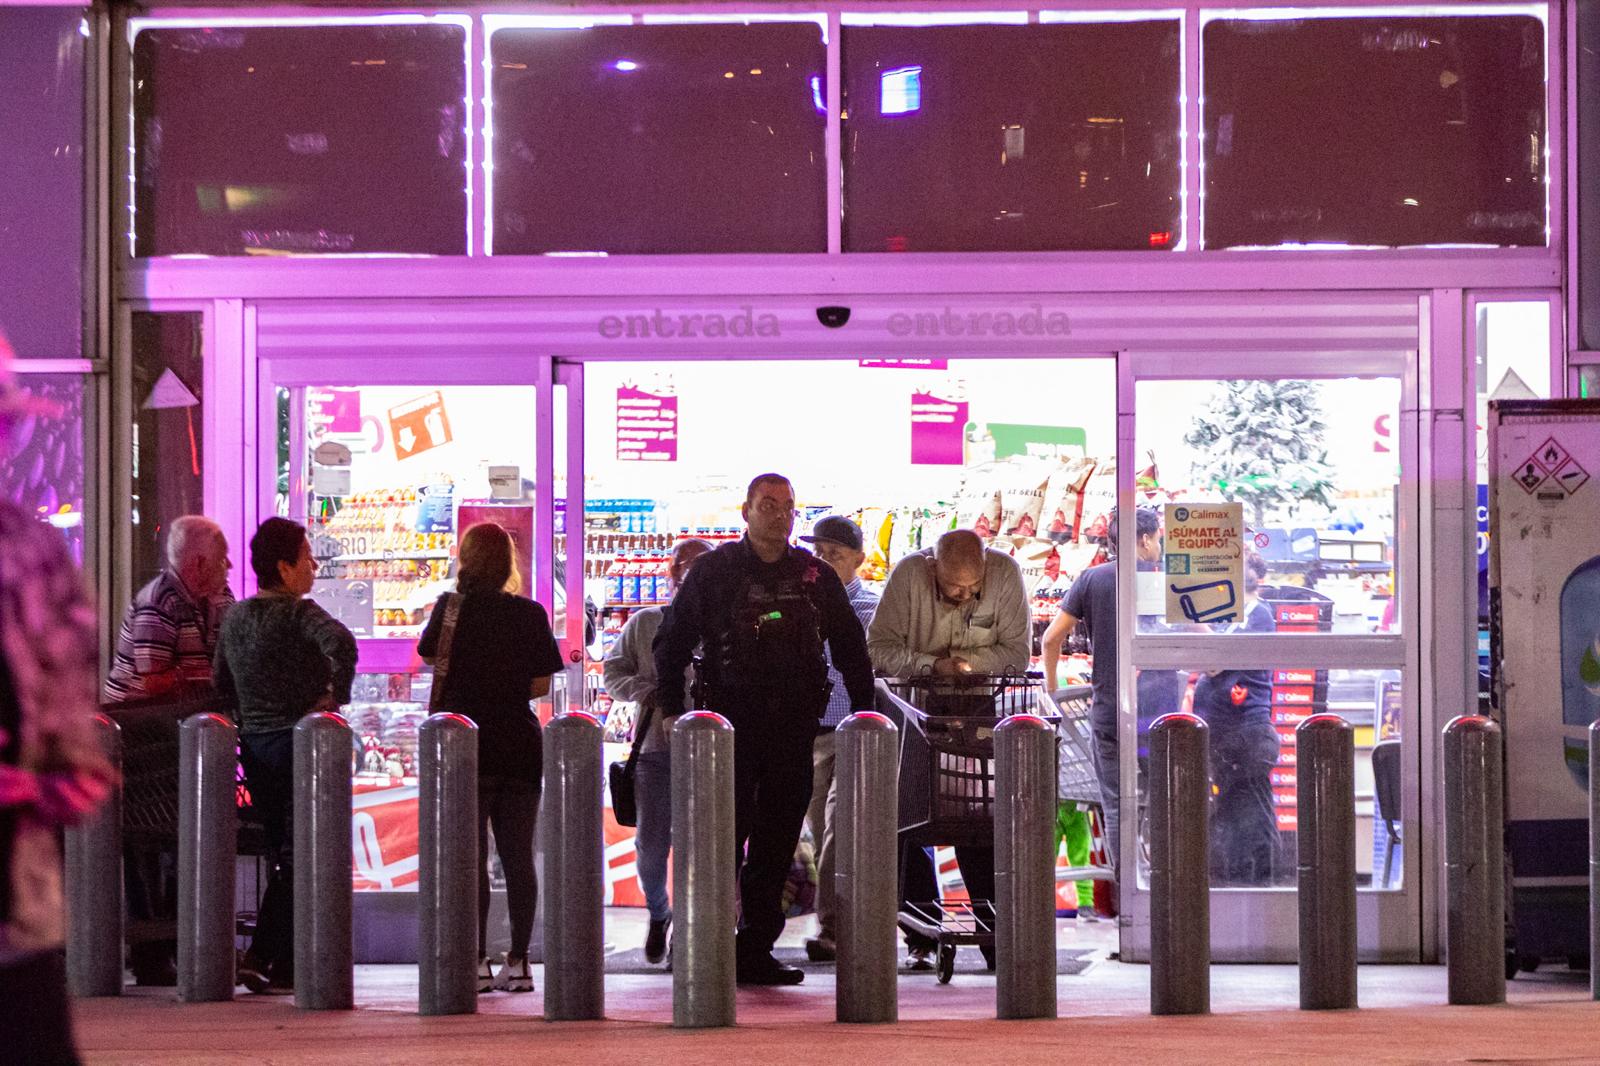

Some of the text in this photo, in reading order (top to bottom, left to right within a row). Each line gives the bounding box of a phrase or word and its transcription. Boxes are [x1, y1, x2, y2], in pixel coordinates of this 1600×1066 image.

[598, 305, 781, 339] entrada
[887, 303, 1072, 337] entrada
[1190, 509, 1230, 520] Calimax
[1168, 526, 1238, 540] ¡SÚMATE AL
[1178, 539, 1229, 549] EQUIPO!
